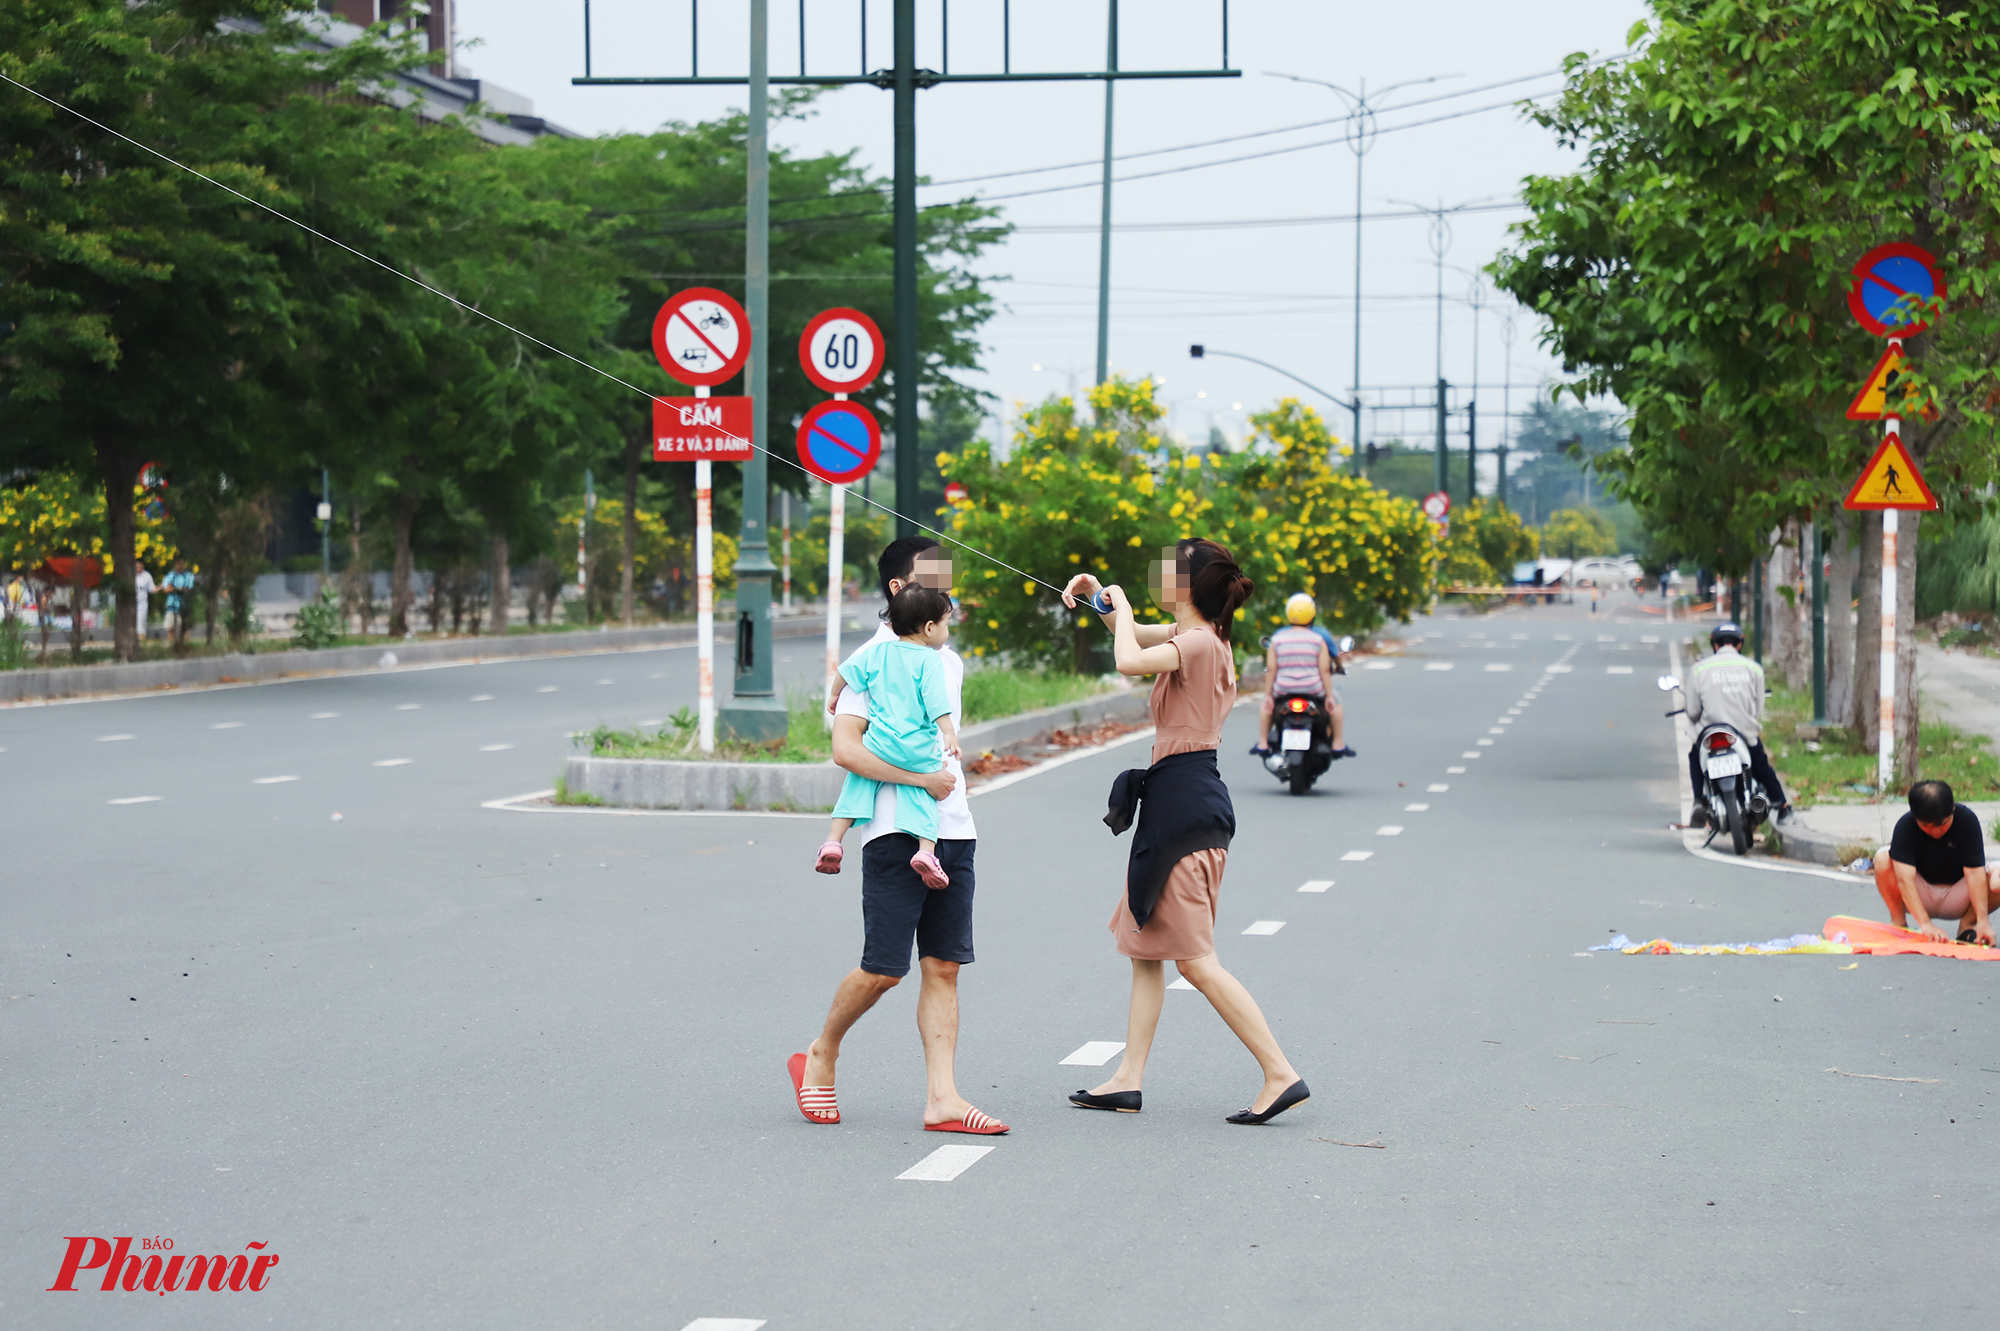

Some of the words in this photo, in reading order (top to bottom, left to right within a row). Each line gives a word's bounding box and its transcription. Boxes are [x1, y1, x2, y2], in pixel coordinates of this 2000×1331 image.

[825, 334, 858, 369] 60
[680, 401, 722, 426] CẤM
[658, 438, 673, 452] XE
[676, 438, 684, 452] 2
[686, 435, 703, 452] VÀ
[704, 438, 712, 452] 3
[715, 436, 749, 452] BÁNH
